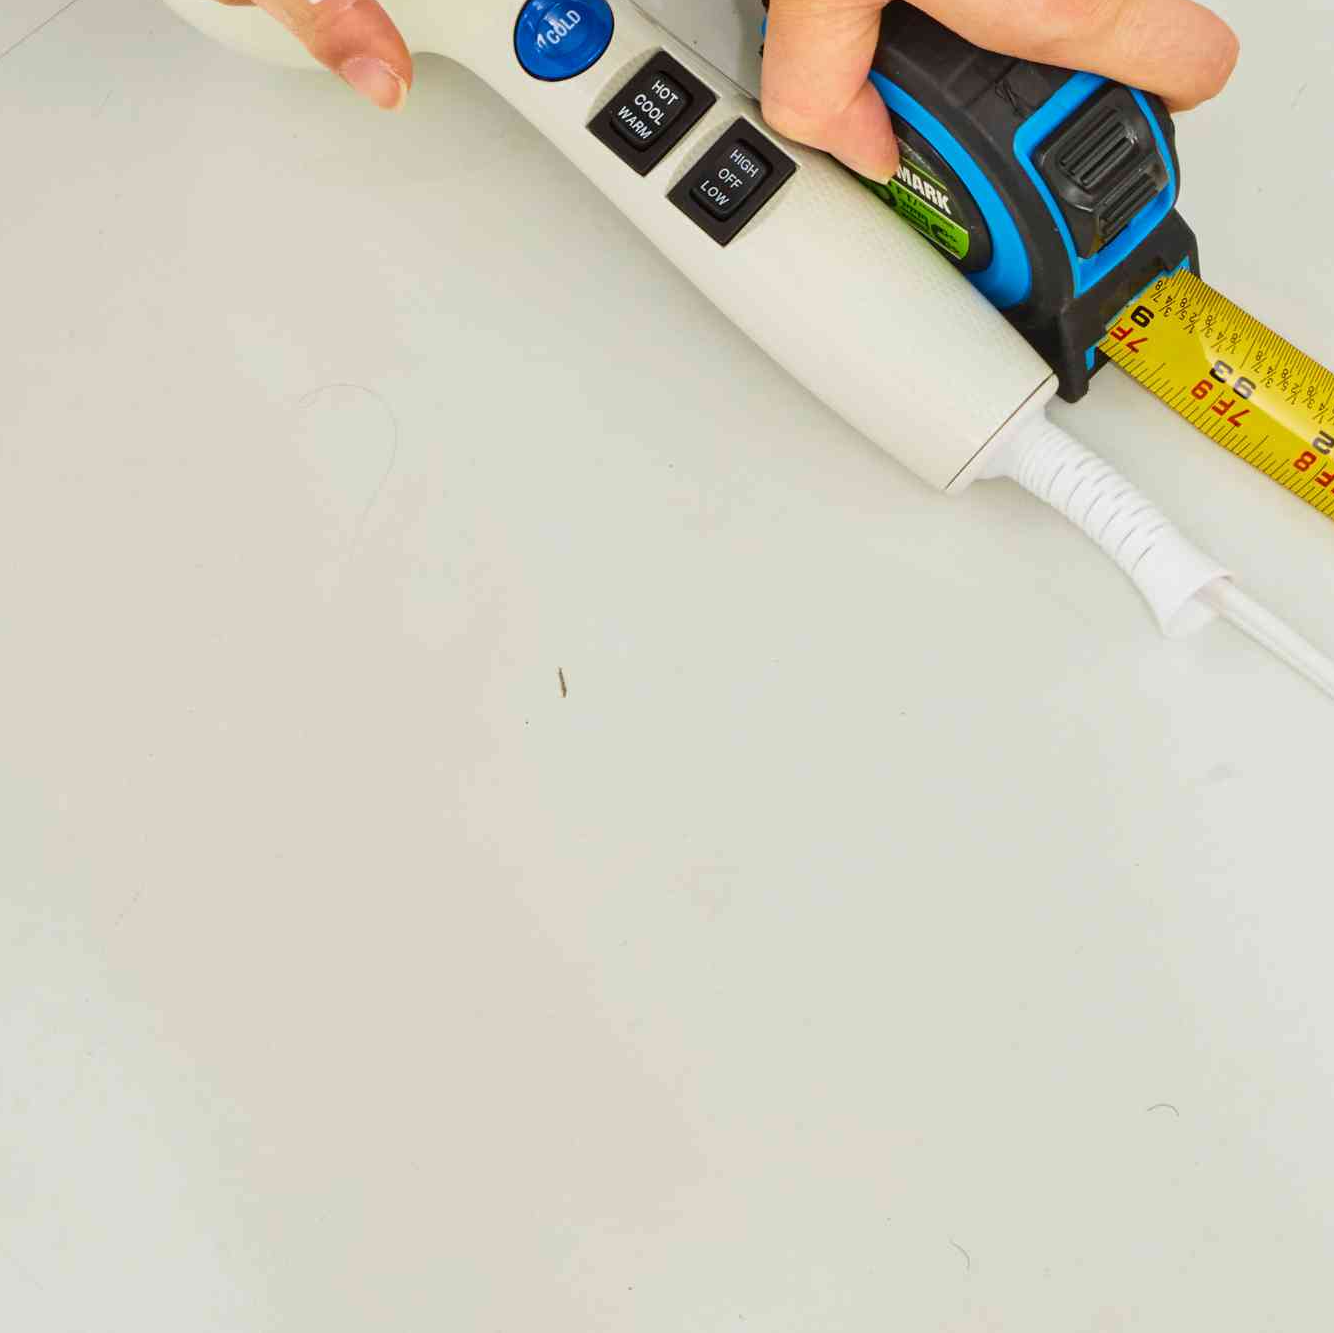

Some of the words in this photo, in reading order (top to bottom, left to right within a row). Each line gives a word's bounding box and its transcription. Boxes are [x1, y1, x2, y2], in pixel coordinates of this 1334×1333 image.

[546, 9, 581, 45] COLD
[652, 80, 678, 105] HOT
[618, 106, 652, 139] WARM
[635, 94, 664, 125] COOL
[730, 149, 759, 178] HIGH
[718, 168, 743, 188] OFF
[700, 180, 730, 206] LOW
[1130, 305, 1154, 327] 9
[1190, 378, 1214, 400] 9
[1209, 360, 1256, 399] 93
[1292, 449, 1318, 473] 8
